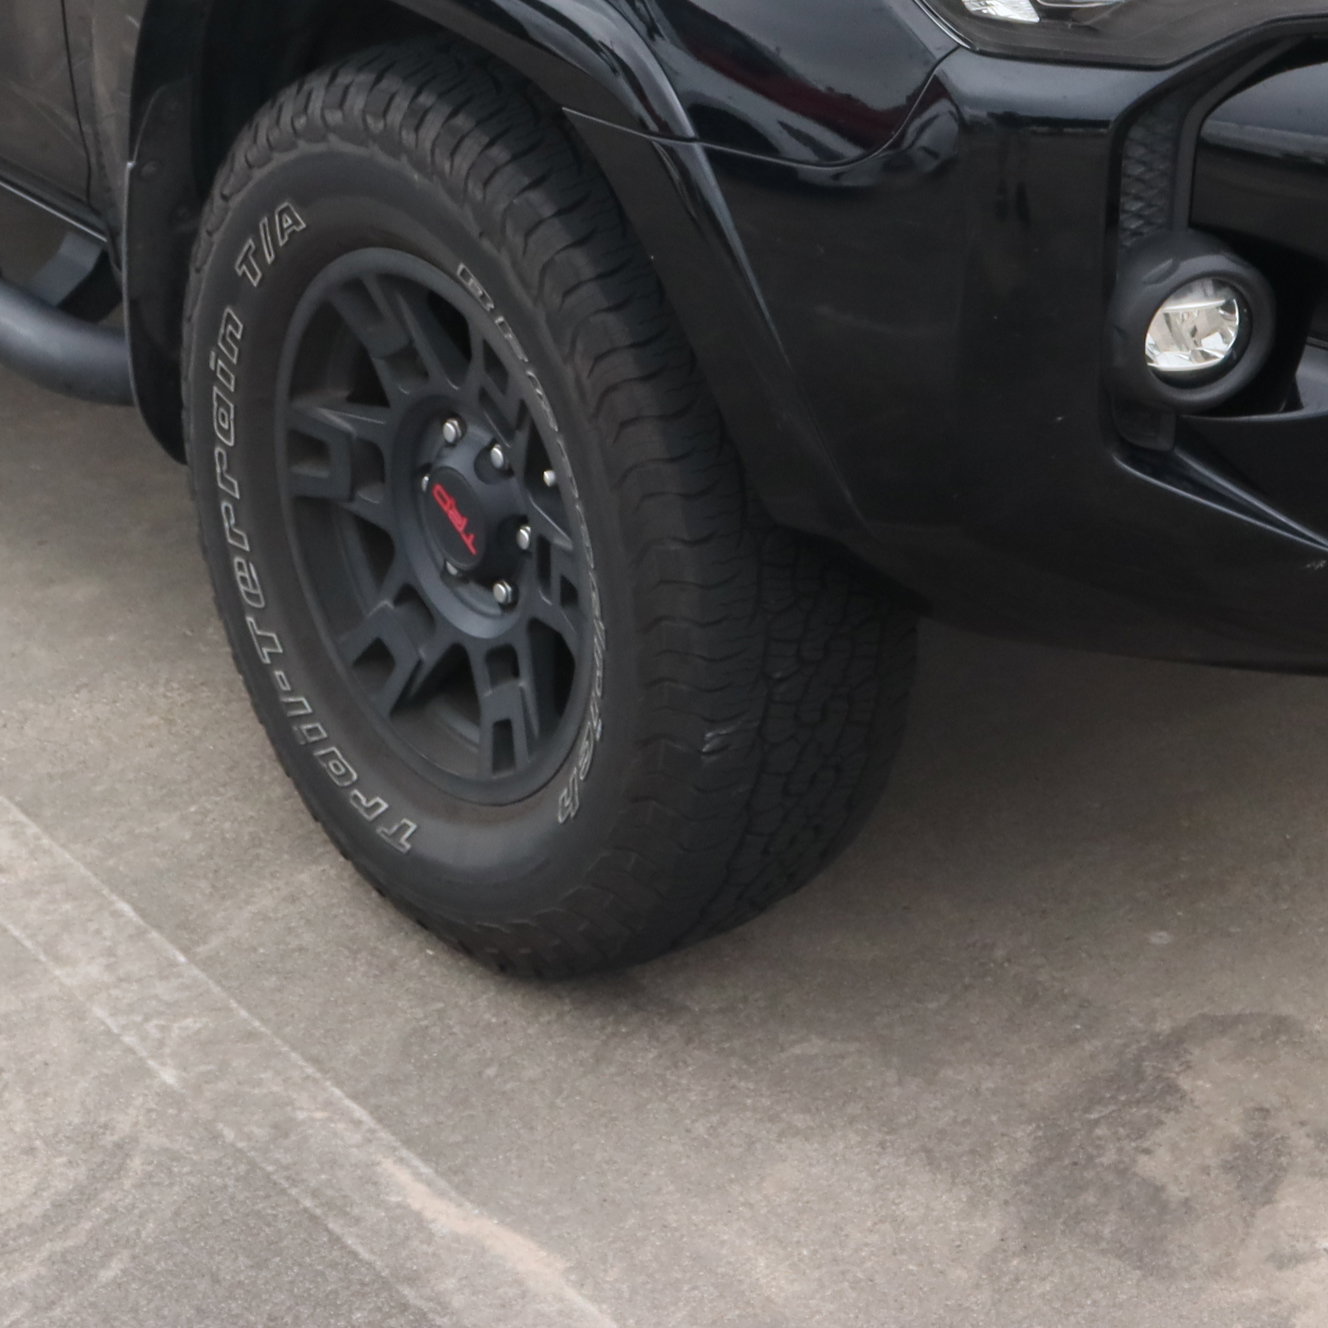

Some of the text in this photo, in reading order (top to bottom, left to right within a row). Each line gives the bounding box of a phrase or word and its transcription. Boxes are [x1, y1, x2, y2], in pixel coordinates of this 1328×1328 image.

[209, 202, 418, 854] Trail-Terrain T/A
[433, 484, 478, 556] TRD
